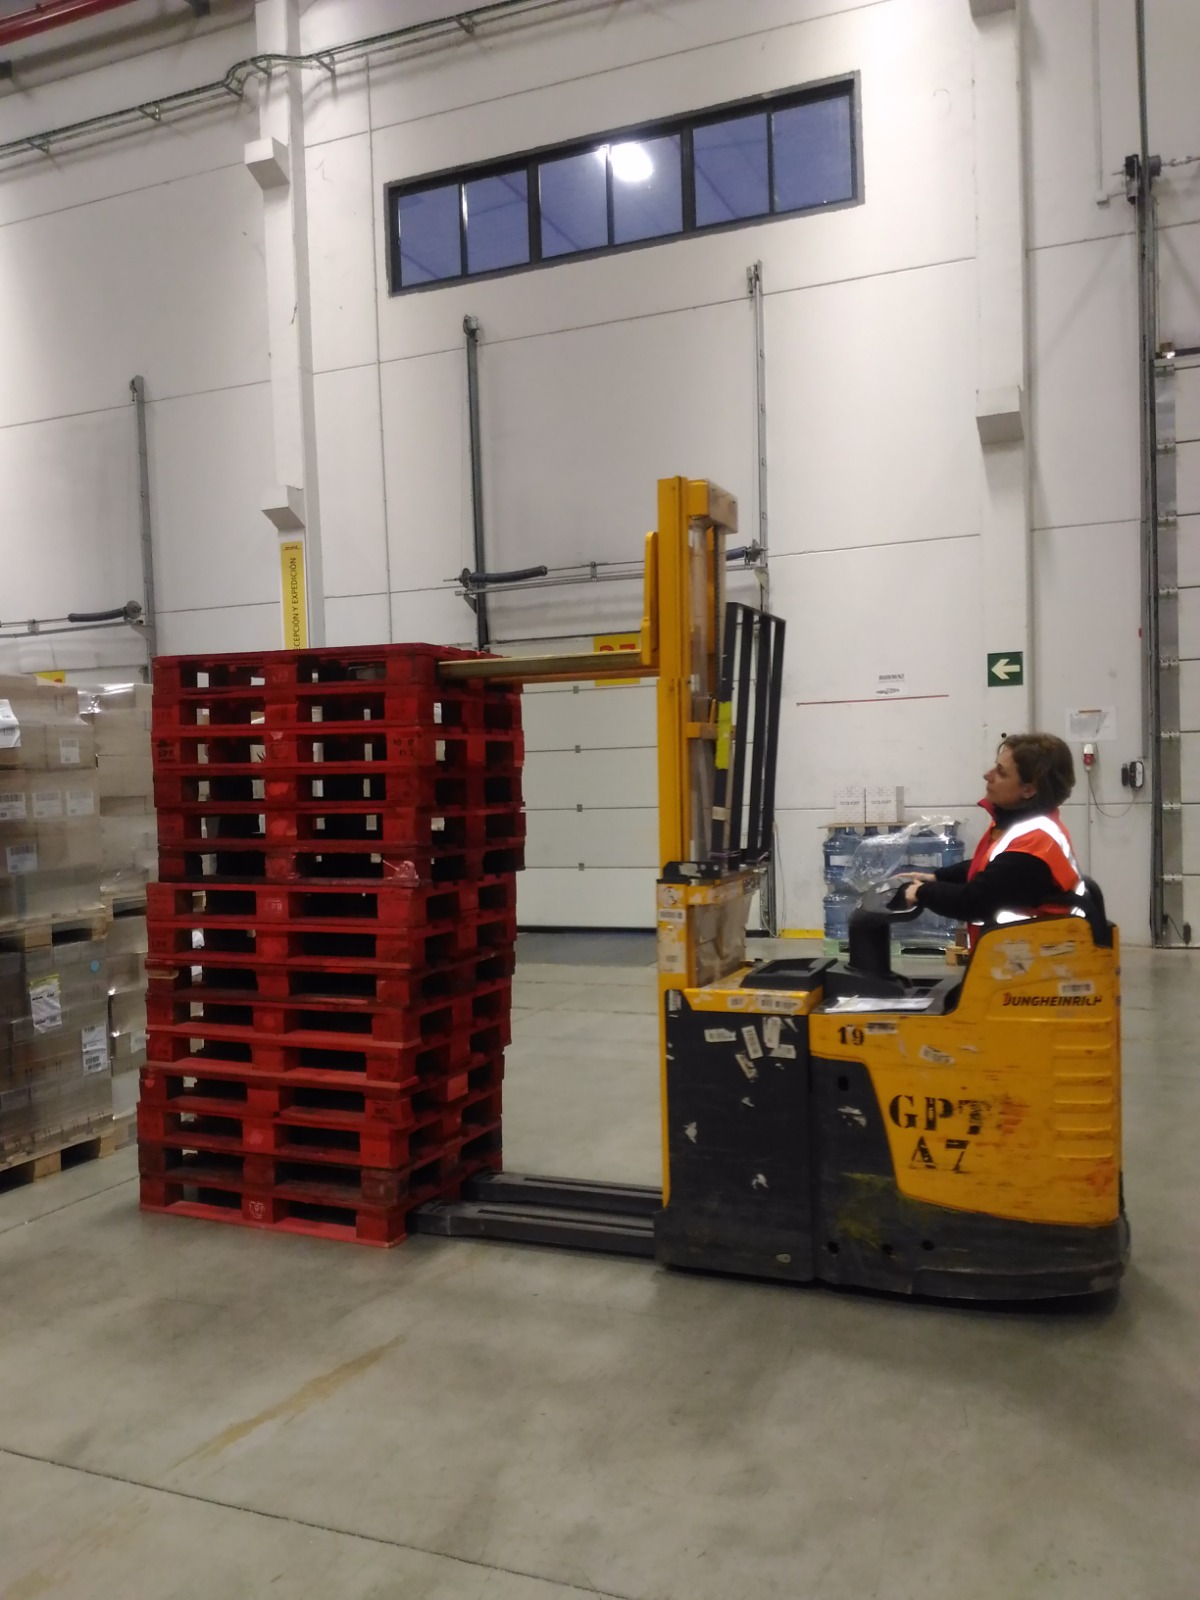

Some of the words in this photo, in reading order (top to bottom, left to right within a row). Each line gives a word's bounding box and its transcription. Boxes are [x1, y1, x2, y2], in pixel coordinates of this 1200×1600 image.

[290, 558, 298, 604] EXPEDICIÓN
[838, 1024, 864, 1046] 19
[908, 1136, 973, 1174] A7
